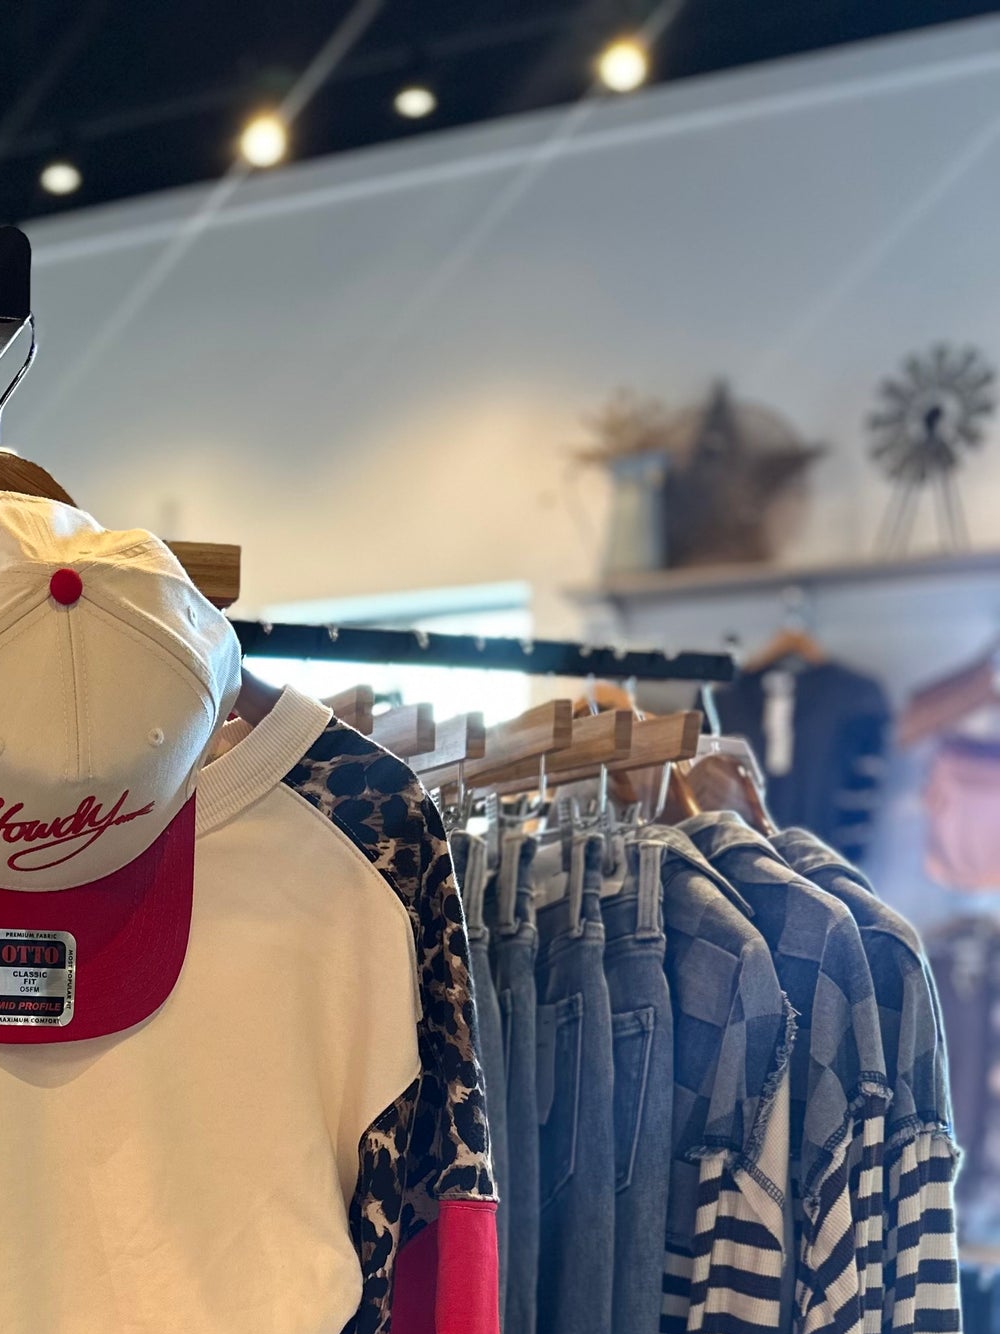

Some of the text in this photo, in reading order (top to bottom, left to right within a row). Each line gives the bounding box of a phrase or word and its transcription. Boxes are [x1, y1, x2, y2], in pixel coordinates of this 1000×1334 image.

[5, 931, 35, 939] PREMIUM
[1, 944, 59, 965] OTTO
[12, 970, 48, 978] CLASSIC
[18, 1002, 61, 1011] PROFILE
